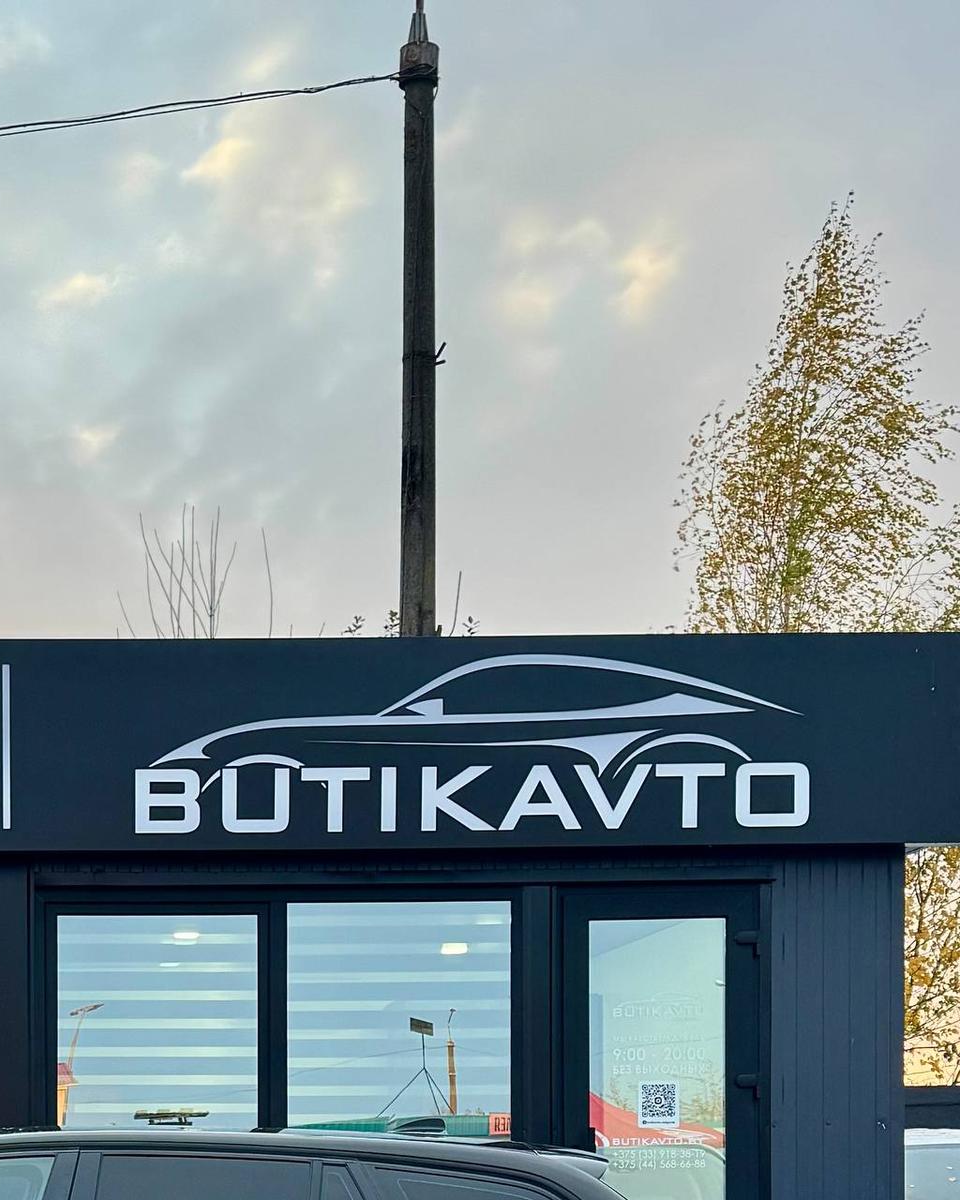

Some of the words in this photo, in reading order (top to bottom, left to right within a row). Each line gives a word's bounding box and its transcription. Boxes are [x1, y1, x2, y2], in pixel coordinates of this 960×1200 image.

[134, 762, 812, 834] BUTIKAVTO
[612, 1047, 645, 1061] 9:00
[663, 1047, 705, 1061] 20:00
[613, 1159, 636, 1169] +375
[638, 1159, 657, 1170] (44)
